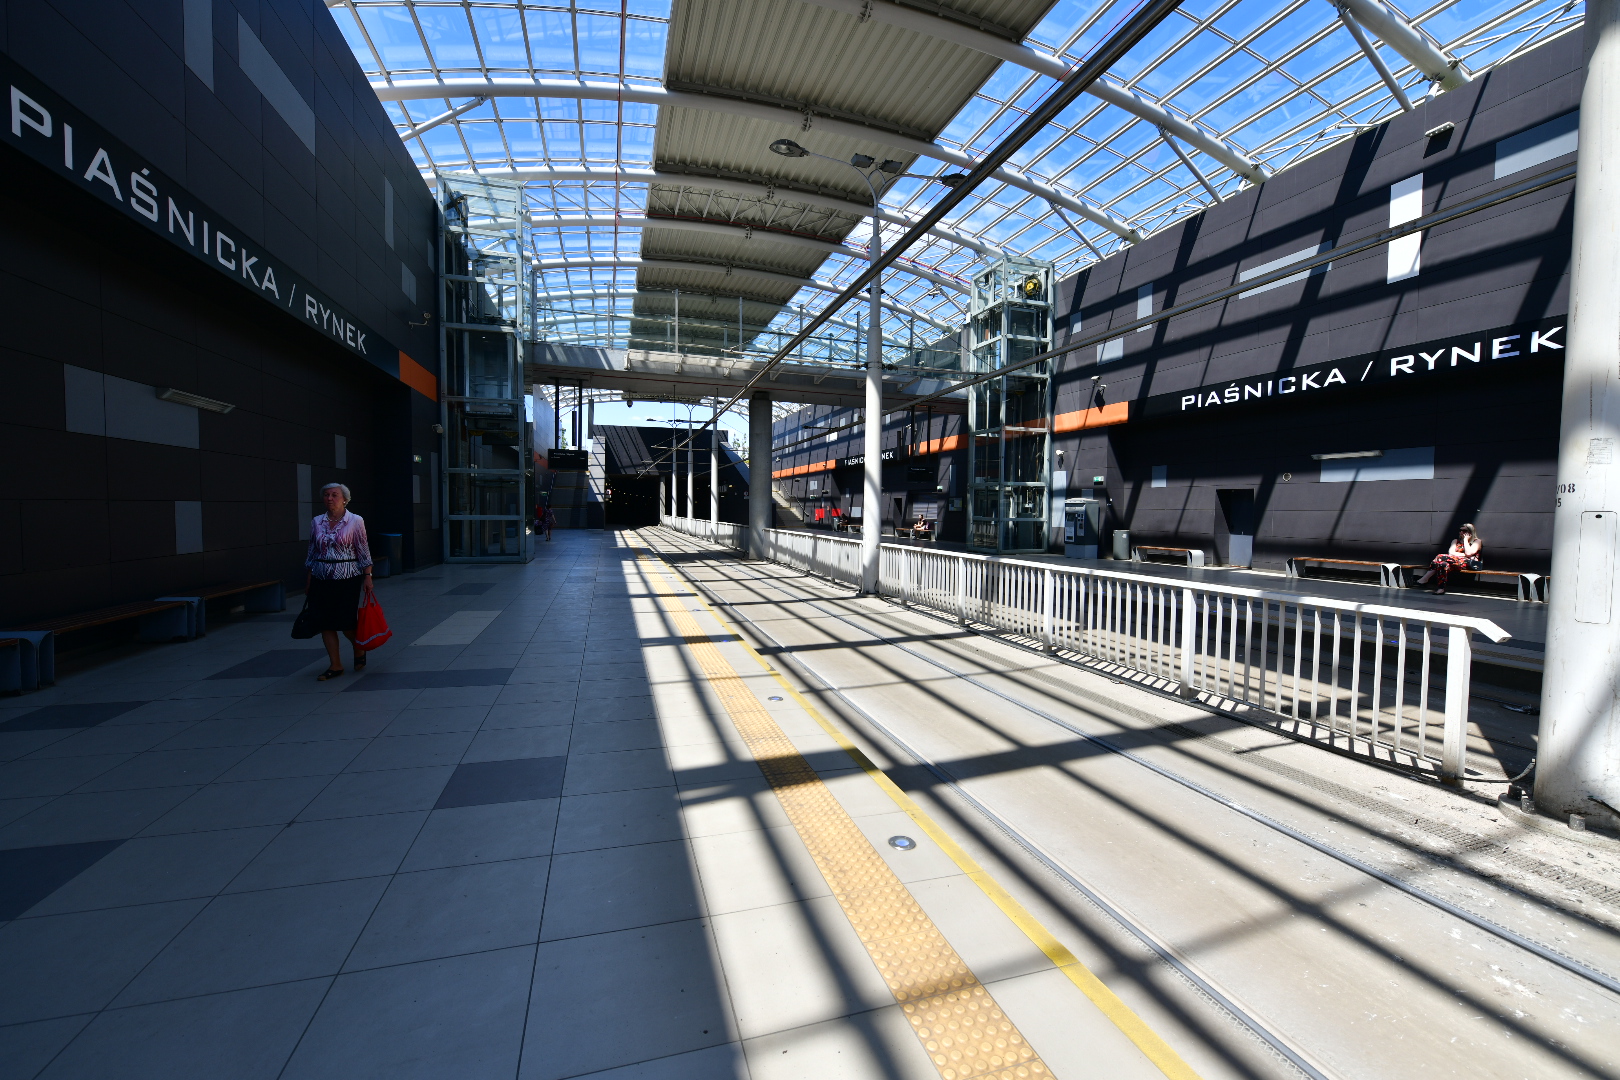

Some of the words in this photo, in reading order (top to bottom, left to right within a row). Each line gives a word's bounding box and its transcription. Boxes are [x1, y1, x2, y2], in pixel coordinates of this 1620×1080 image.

[10, 84, 280, 301] PIAŚNICKA
[305, 293, 368, 355] RYNEK
[1181, 368, 1347, 410] PIAŚNICKA
[1390, 326, 1565, 377] RYNEK
